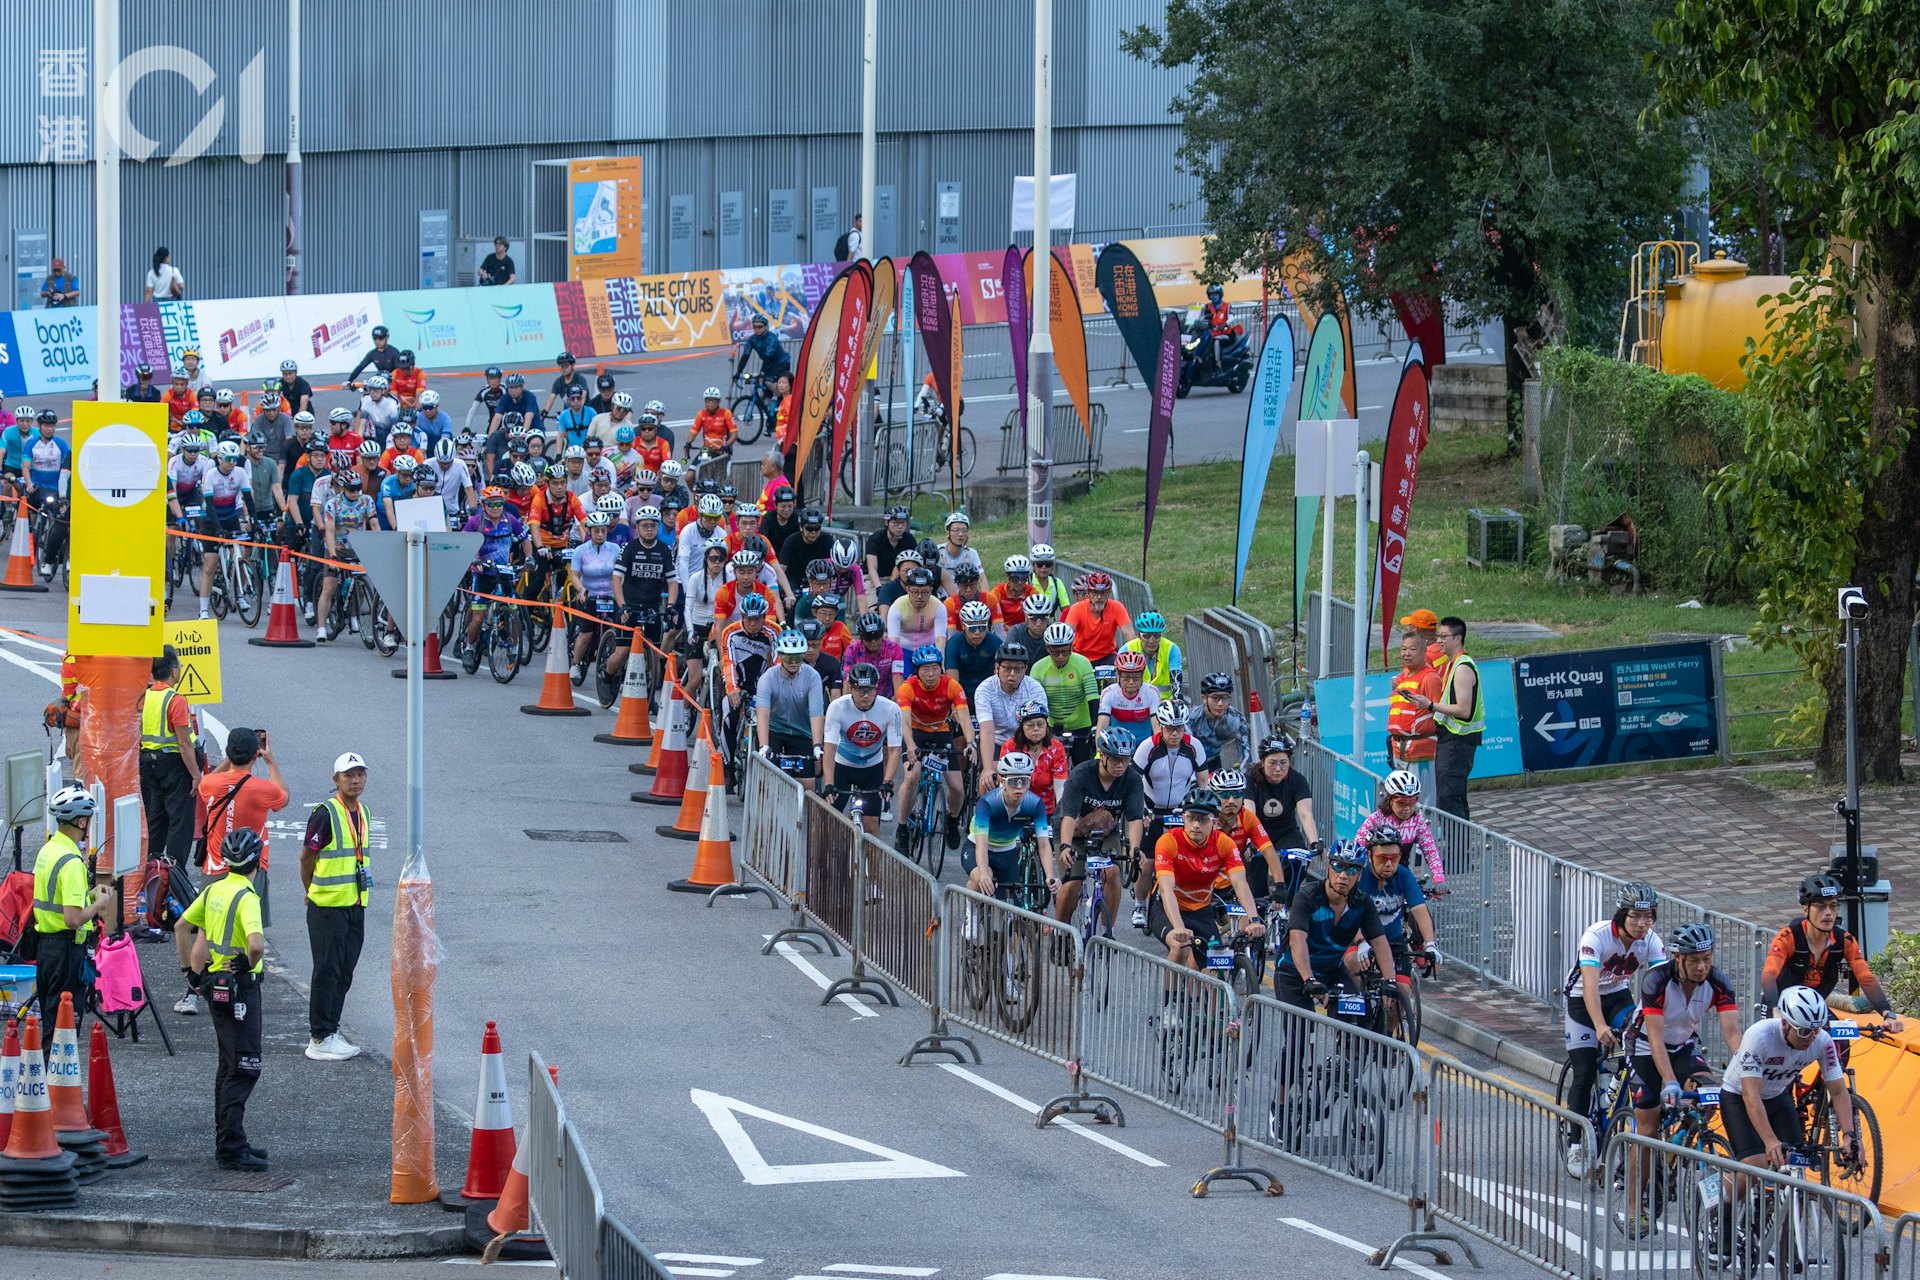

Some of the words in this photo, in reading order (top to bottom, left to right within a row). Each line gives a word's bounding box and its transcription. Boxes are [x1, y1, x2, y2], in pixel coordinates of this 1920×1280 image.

[640, 281, 665, 299] THE
[668, 278, 697, 298] CITY
[698, 277, 710, 295] IS
[1116, 295, 1137, 304] HONG
[643, 299, 667, 318] ALL
[670, 295, 714, 316] YOURS
[1117, 303, 1138, 312] KONG
[34, 317, 73, 344] bon
[41, 344, 89, 372] aqua
[1263, 394, 1278, 406] HONG
[1263, 406, 1277, 418] KONG
[1405, 482, 1415, 516] Hung
[1402, 516, 1410, 531] Sun
[632, 563, 662, 573] KEEP
[631, 571, 662, 580] PEDAL
[175, 630, 202, 645] 小心
[176, 645, 211, 657] aution
[1650, 662, 1677, 671] WestK
[1677, 659, 1700, 670] Ferry
[1568, 669, 1604, 685] Quay
[1622, 682, 1648, 690] Minutes
[1655, 679, 1678, 687] Central
[1546, 688, 1583, 700] 西九碼頭
[1619, 715, 1646, 724] 水上的士
[1639, 722, 1653, 730] Taxi
[1496, 735, 1514, 745] Quay
[1364, 750, 1388, 758] Freespa
[1212, 957, 1230, 966] 7680
[1344, 1003, 1361, 1011] 7605
[1795, 1156, 1811, 1164] 701
